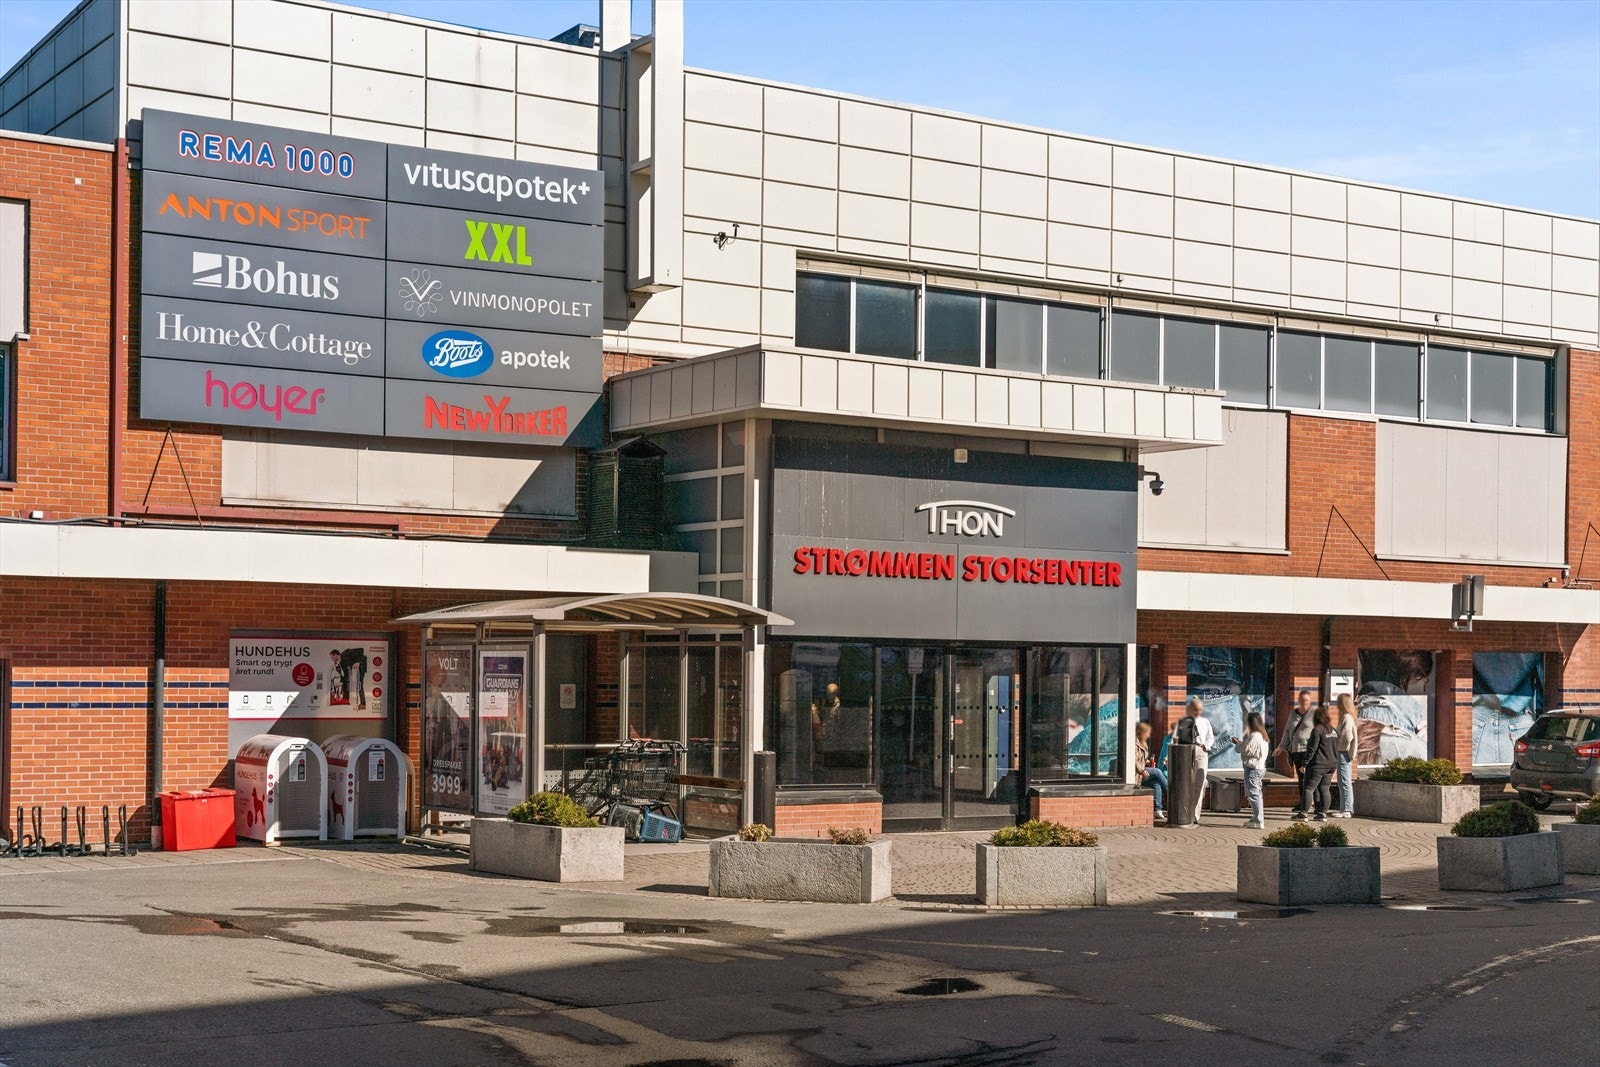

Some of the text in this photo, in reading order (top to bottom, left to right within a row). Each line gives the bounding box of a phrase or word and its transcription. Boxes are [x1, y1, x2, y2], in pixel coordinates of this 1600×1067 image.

[178, 129, 356, 180] REMA 1000
[159, 192, 371, 240] ANTON SPORT
[464, 219, 533, 267] XXL
[225, 254, 340, 302] Bohus
[449, 289, 593, 319] VINMONOPOLET
[428, 337, 571, 371] Boots apotek
[205, 369, 325, 422] høyer
[915, 499, 1016, 537] THON
[794, 546, 1123, 588] STRØMMEN STORSENTER
[235, 646, 311, 658] HUNDEHUS
[235, 659, 293, 668] Smart og trygt
[439, 658, 459, 670] VOLT
[486, 678, 519, 689] GUARDIANS
[432, 774, 461, 795] 3999
